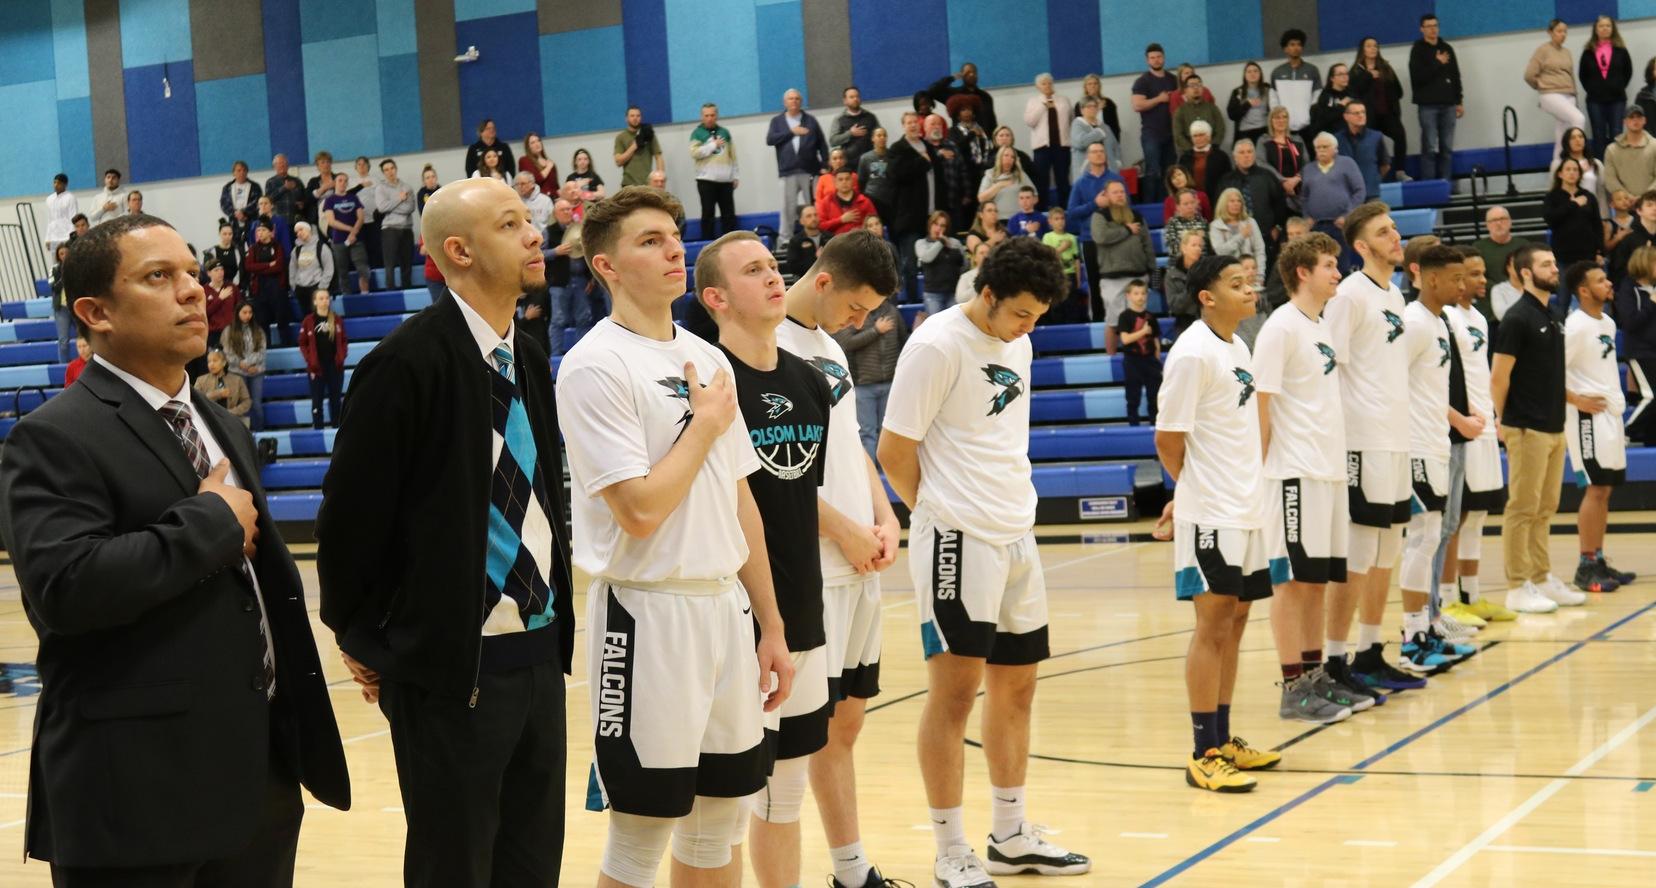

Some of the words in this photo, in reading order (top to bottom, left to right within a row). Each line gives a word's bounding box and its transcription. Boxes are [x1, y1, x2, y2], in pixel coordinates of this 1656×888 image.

[749, 425, 796, 448] OLSOM
[1285, 485, 1299, 543] FALCONS
[937, 528, 958, 600] ALCONS
[600, 631, 628, 738] FALCONS
